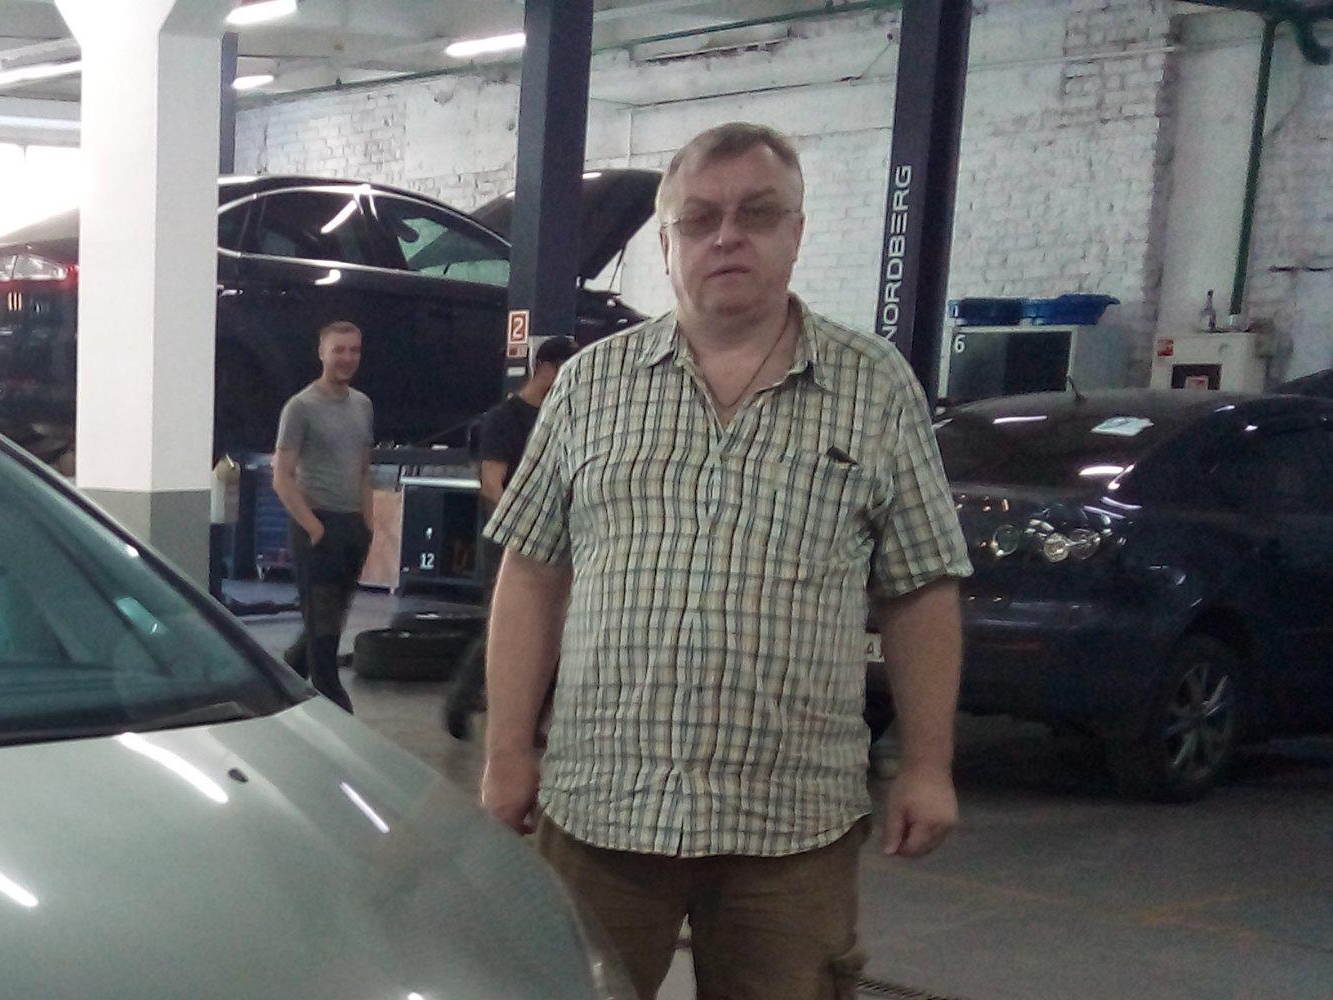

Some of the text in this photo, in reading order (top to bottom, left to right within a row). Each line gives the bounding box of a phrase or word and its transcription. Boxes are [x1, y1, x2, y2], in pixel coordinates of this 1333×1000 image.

[882, 165, 912, 341] NORDBERG
[512, 316, 524, 339] 2
[954, 334, 966, 353] 6
[419, 552, 435, 570] 12
